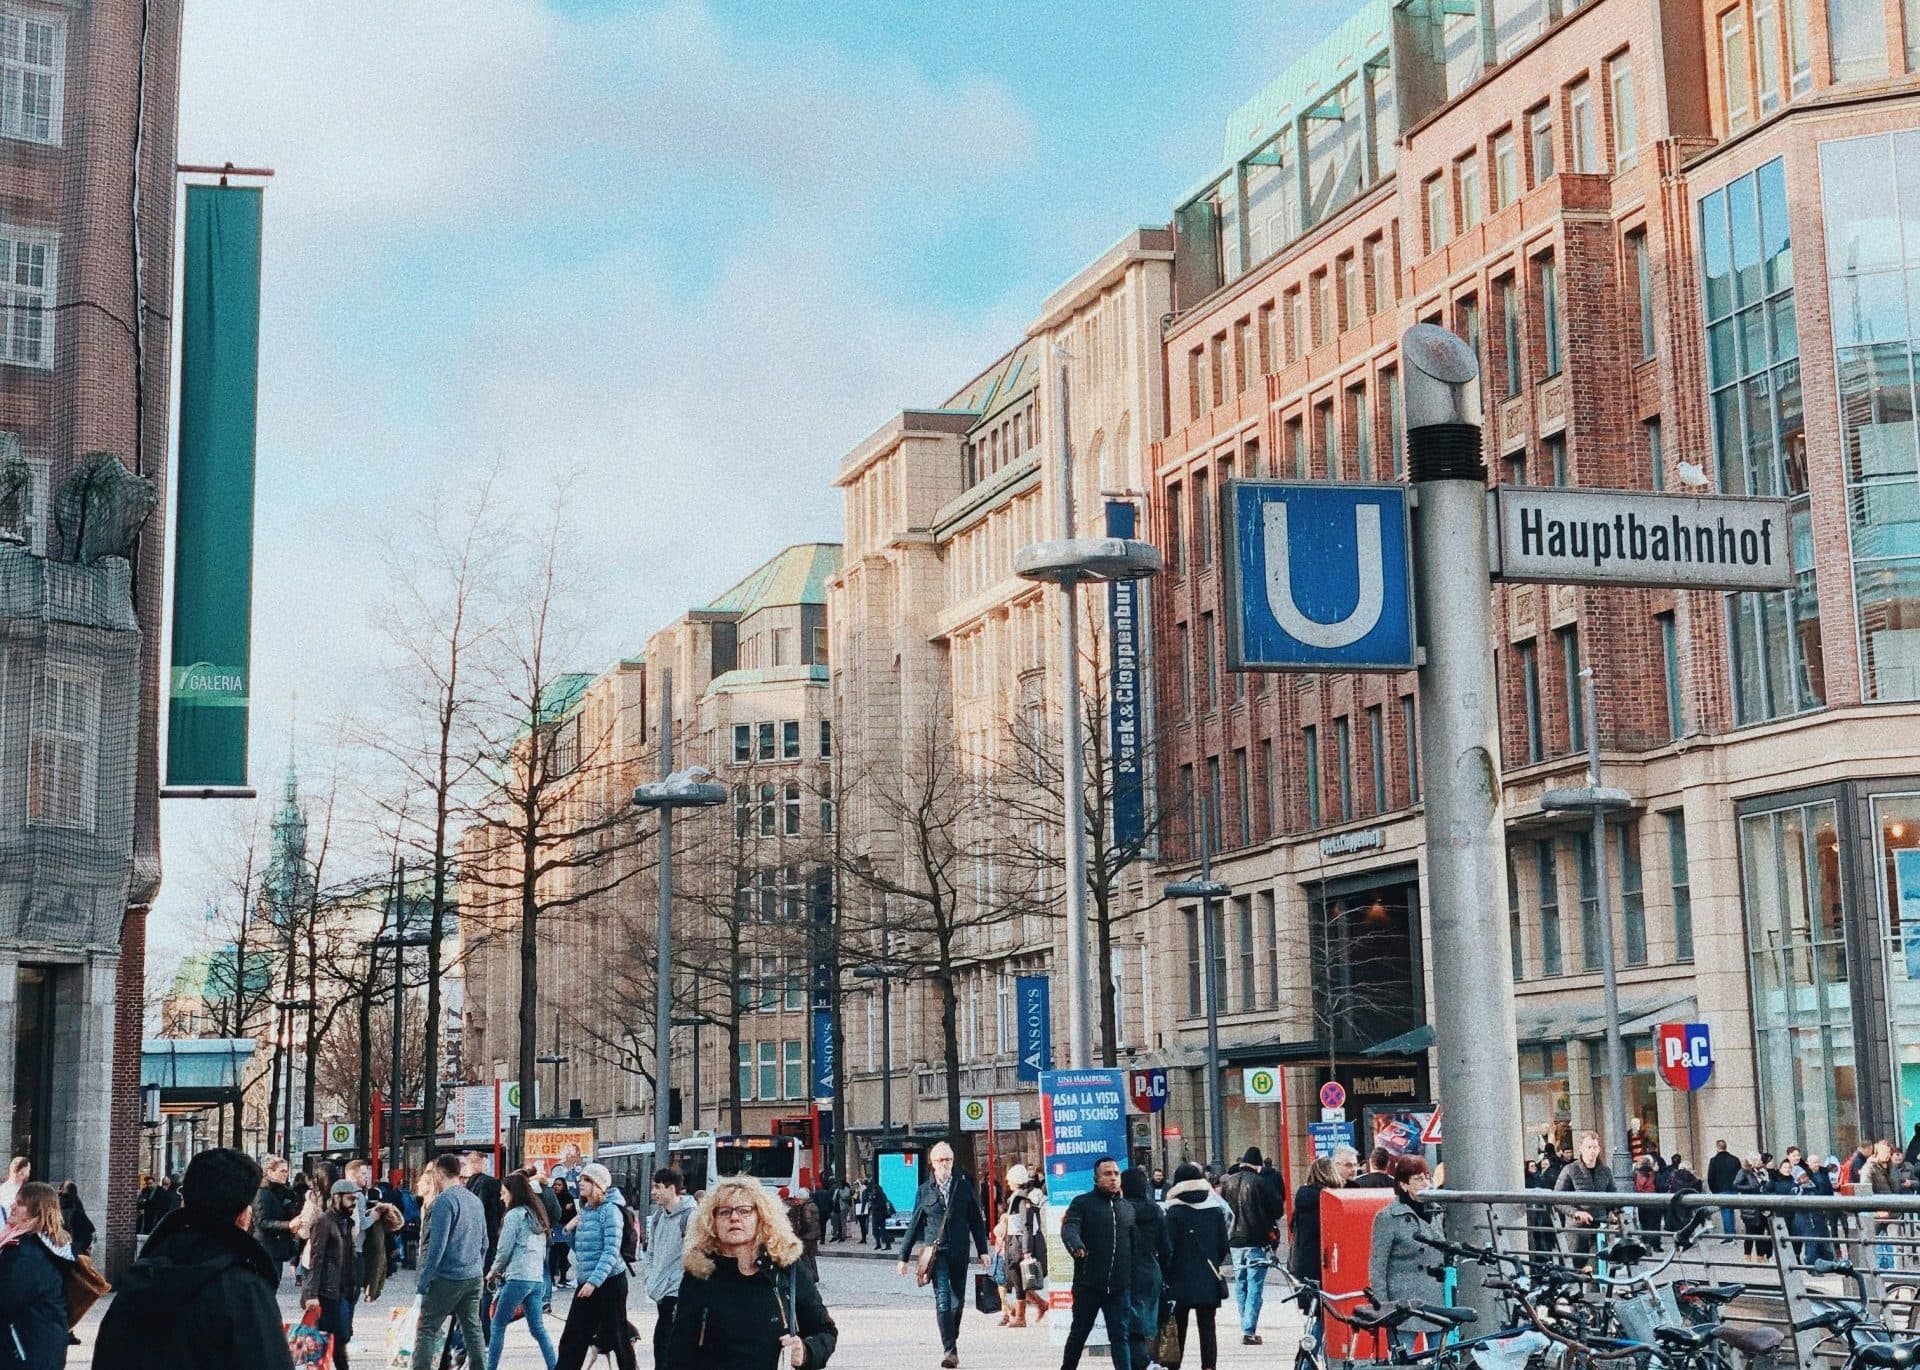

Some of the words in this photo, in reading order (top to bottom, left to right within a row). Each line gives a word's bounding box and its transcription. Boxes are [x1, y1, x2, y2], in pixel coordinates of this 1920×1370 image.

[1520, 507, 1772, 566] Hauptbahnhof
[1262, 501, 1385, 648] U
[190, 675, 243, 691] GALERIA
[1113, 580, 1136, 773] Peek&Cloppenbur
[1023, 988, 1043, 1071] ANSON'S
[1664, 1036, 1709, 1068] P&C
[1135, 1075, 1165, 1097] P&C
[1081, 1093, 1093, 1105] LA
[1095, 1091, 1120, 1105] VISTA
[1053, 1108, 1078, 1122] UND
[1080, 1106, 1119, 1121] TSCHÜSS
[1055, 1125, 1083, 1139] FREIE
[1056, 1140, 1108, 1155] MEINUNG!
